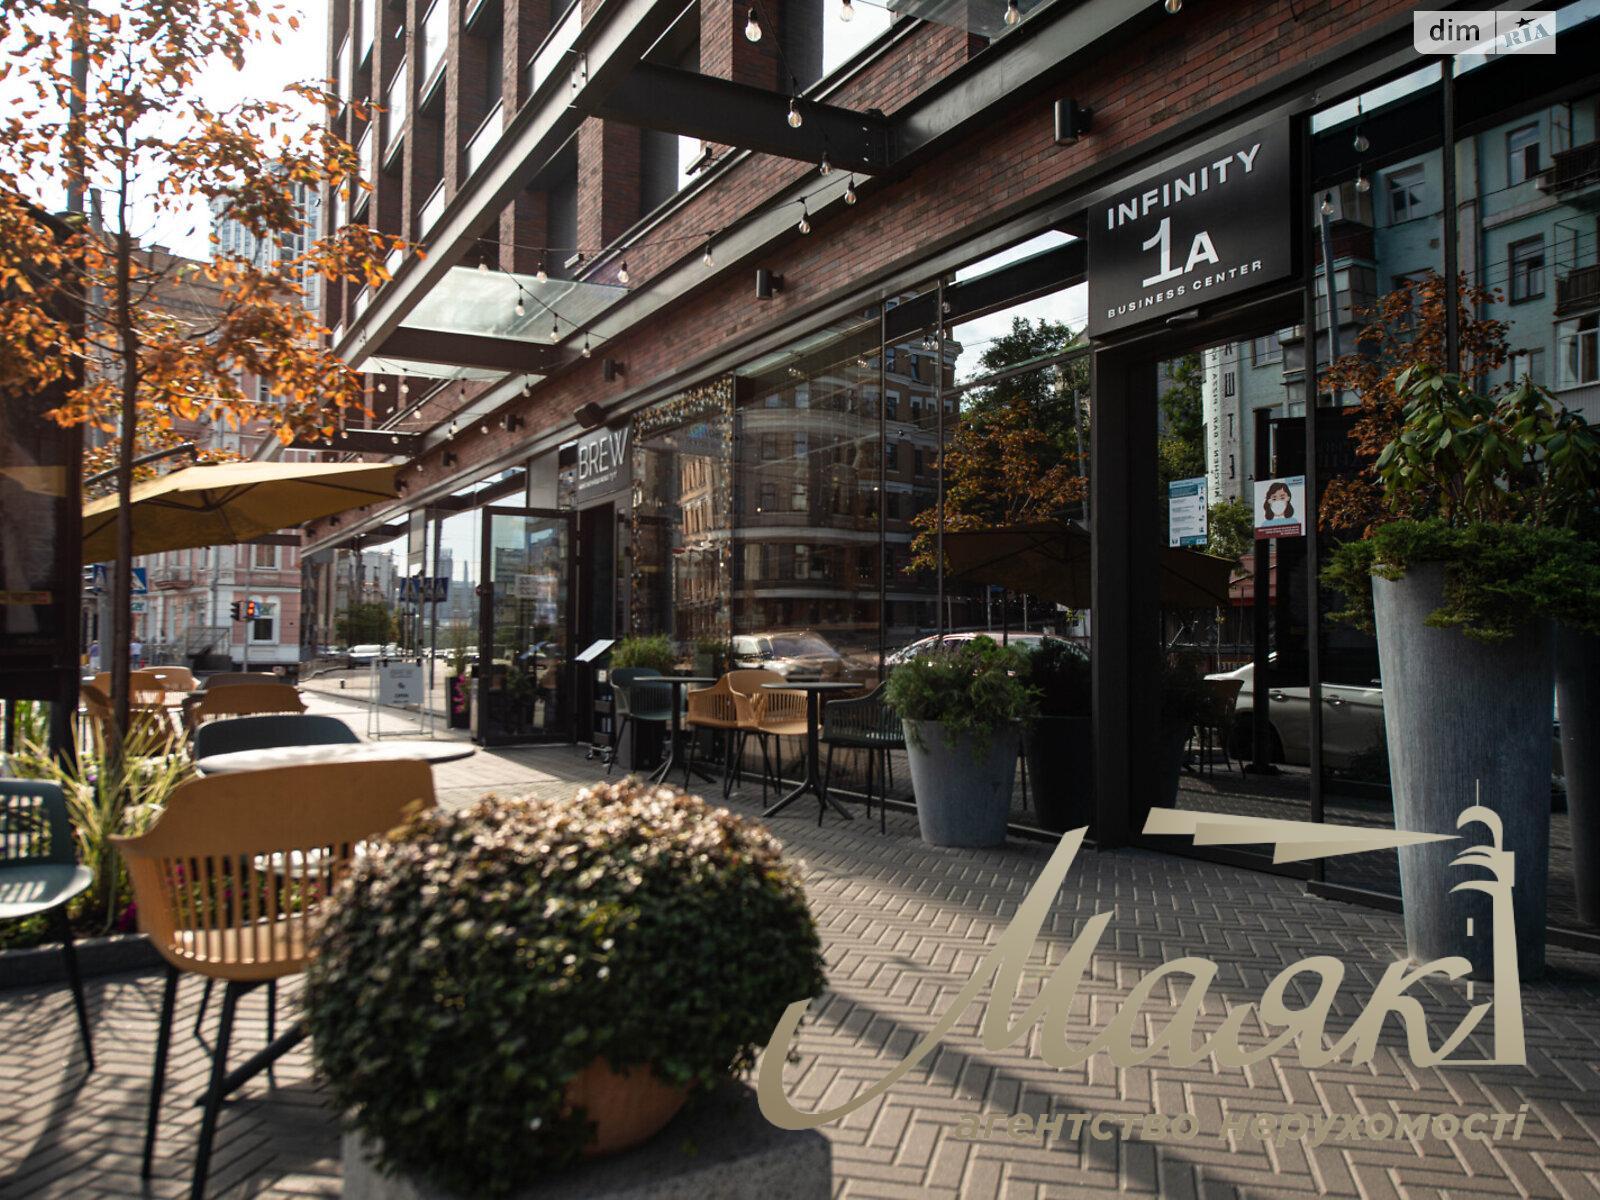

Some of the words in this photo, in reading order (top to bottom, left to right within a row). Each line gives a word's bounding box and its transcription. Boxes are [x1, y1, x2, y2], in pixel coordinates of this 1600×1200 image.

[1107, 143, 1262, 230] INFINITY
[1142, 216, 1219, 288] 1A
[1107, 285, 1186, 319] BUSINESS
[1192, 260, 1263, 291] CENTER
[578, 428, 629, 480] BREW
